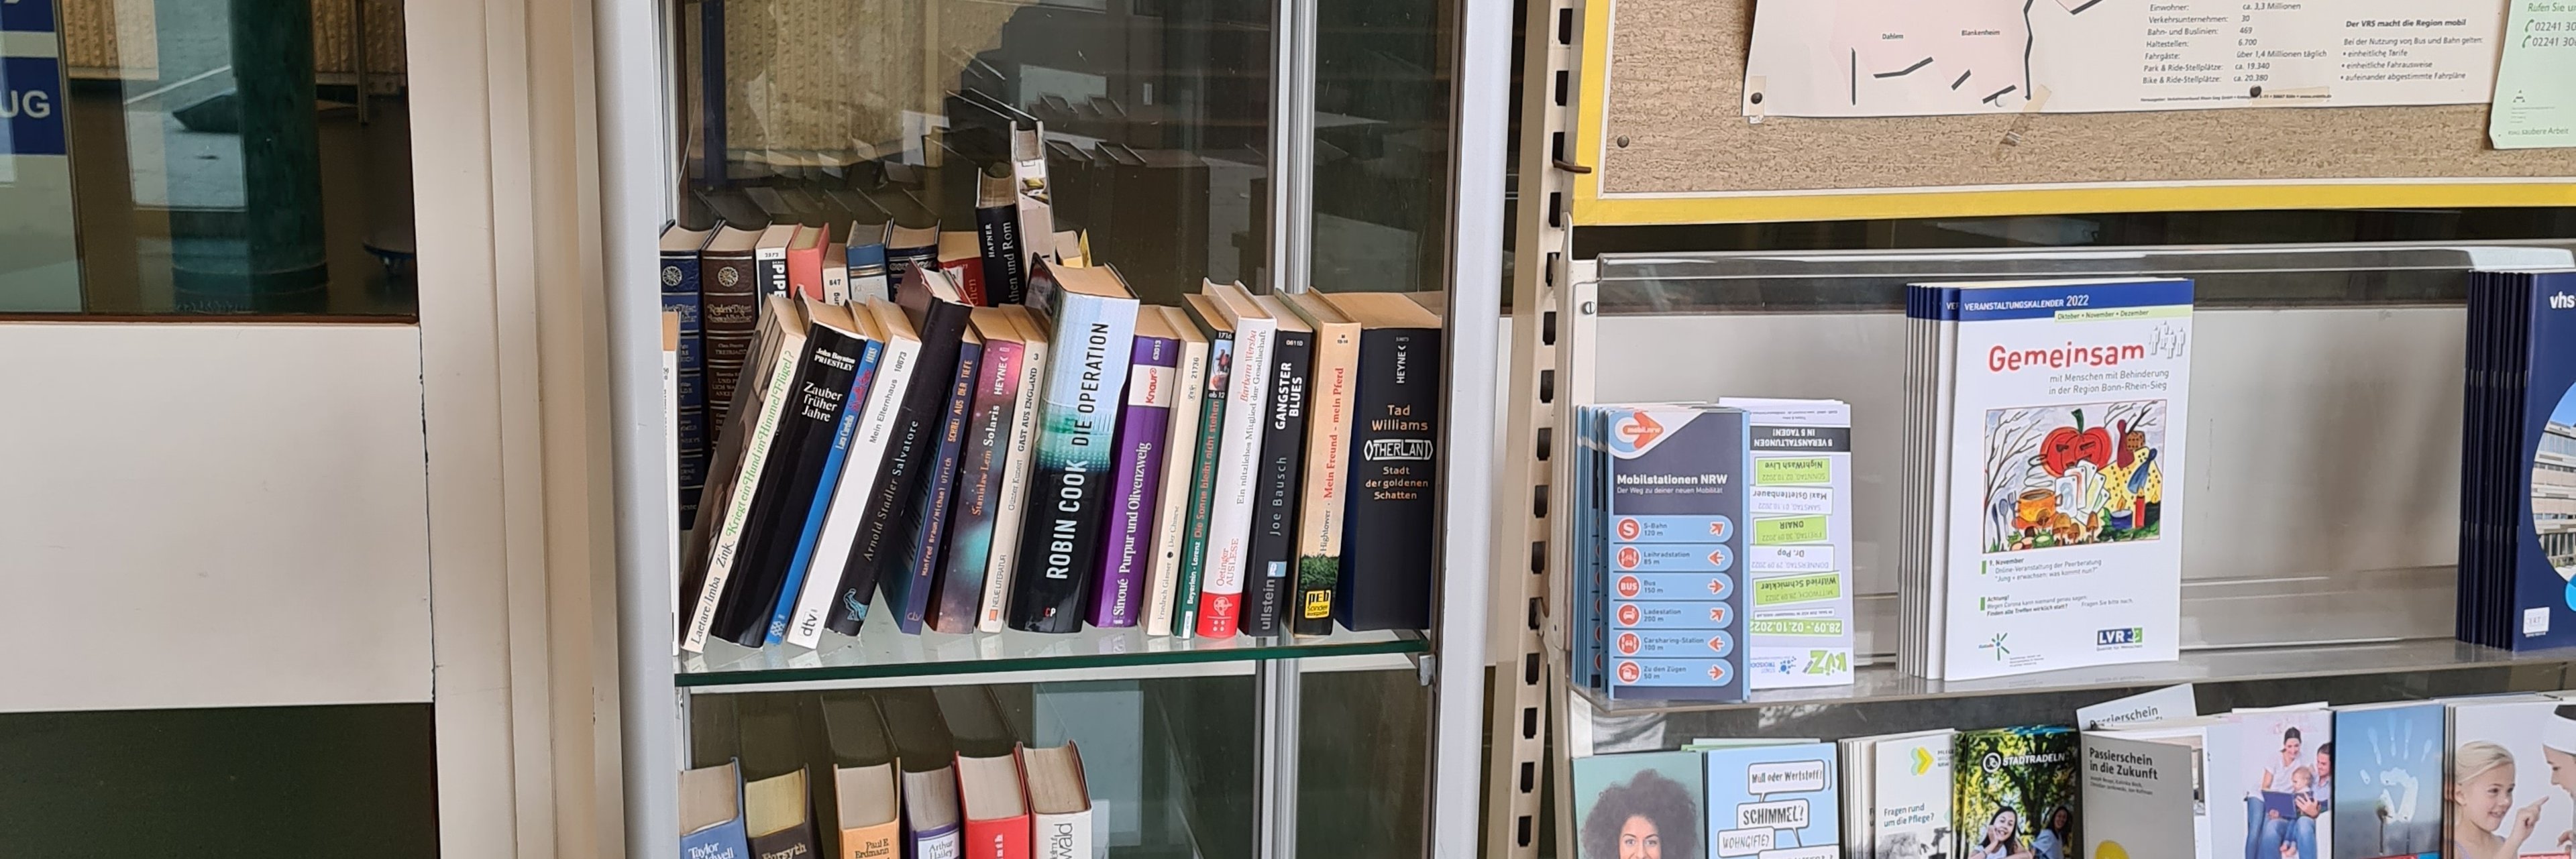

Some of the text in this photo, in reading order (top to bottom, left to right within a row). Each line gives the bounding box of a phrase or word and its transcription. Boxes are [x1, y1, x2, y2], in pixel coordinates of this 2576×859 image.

[2552, 2, 2565, 11] Sie
[2416, 19, 2443, 28] Region
[2535, 21, 2561, 31] 02241
[2369, 38, 2398, 46] Nutzung
[2532, 37, 2559, 46] 02241
[2388, 49, 2408, 57] Tarife
[985, 223, 995, 258] HAFNER
[1002, 221, 1012, 251] Rom
[1964, 295, 2089, 311] VERANSTALTUNGSKALENDER 2022
[2550, 290, 2575, 309] vhs
[2057, 309, 2149, 320] Oktober November Dezember
[1218, 331, 1232, 339] 1716
[814, 355, 855, 371] PRIESTLEY
[1988, 341, 2145, 372] Gemeinsam
[961, 359, 973, 378] TIEFE
[1397, 352, 1406, 384] HEYNE
[2049, 368, 2169, 384] mit Menschen mit Behinderung
[994, 362, 1007, 395] HEYNE
[804, 382, 843, 401] Zauber
[957, 382, 968, 396] DER
[1275, 363, 1292, 430] GANGSTER
[1289, 377, 1302, 416] BLUES
[2049, 381, 2167, 396] in der Region Bonn-Rhein-Sieg
[804, 394, 838, 412] früher
[869, 379, 898, 443] Mein Elternhaus
[954, 400, 964, 415] AUS
[1018, 367, 1038, 452] GAST AUS ENGLAND
[1387, 404, 1411, 416] Tad
[802, 405, 830, 422] Jahre
[1210, 401, 1220, 432] stehen
[1237, 330, 1267, 505] Ein nützliches Mitglied Gesellschaft
[983, 405, 1000, 447] Solaris
[1324, 368, 1344, 499] Mein Freund mein Pferd
[1371, 420, 1428, 431] Williams
[1046, 323, 1110, 580] ROBIN COOK DIE OPERATION
[1206, 434, 1215, 459] nicht
[1754, 439, 1827, 447] VERANSTALTUNGEN
[980, 450, 992, 471] Lem
[1765, 460, 1780, 468] Live
[1383, 466, 1411, 475] Stadt
[1617, 473, 1728, 484] Mobilstationen NRW
[716, 397, 781, 569] Zink Kriegt Hund Himmel
[863, 420, 919, 561] Arnold Stadler Salvatore
[1365, 478, 1429, 490] der goldenen
[1630, 487, 1644, 495] Weg
[1269, 457, 1287, 536] Joe Bausch
[1374, 491, 1417, 500] Schatten
[1195, 491, 1208, 520] Sonne
[1113, 442, 1152, 616] Sinoué Purpur und Olivenzweig
[921, 546, 933, 577] Manfred
[1191, 541, 1201, 565] Lorenz
[1778, 549, 1791, 557] Pop
[1216, 548, 1229, 587] Oetinger
[1226, 538, 1239, 586] AUSLESE
[1187, 571, 1197, 604] Beyerlein
[1621, 582, 1638, 591] BUS
[1761, 577, 1836, 590] Wilfried Schmickler
[1260, 579, 1275, 630] ullstein
[2098, 631, 2125, 644] LVR
[2002, 753, 2065, 766] STADTRADELN
[2090, 747, 2153, 766] Passierschein
[1768, 771, 1782, 783] oder
[2090, 760, 2158, 780] in die Zukunft
[1743, 805, 1804, 825] SCHIMMEL?
[1884, 803, 1925, 816] Fragen rund
[1884, 813, 1935, 827] um die Pflege?
[928, 840, 953, 853] Arthur
[1723, 834, 1770, 849] WOHNGIFTE?
